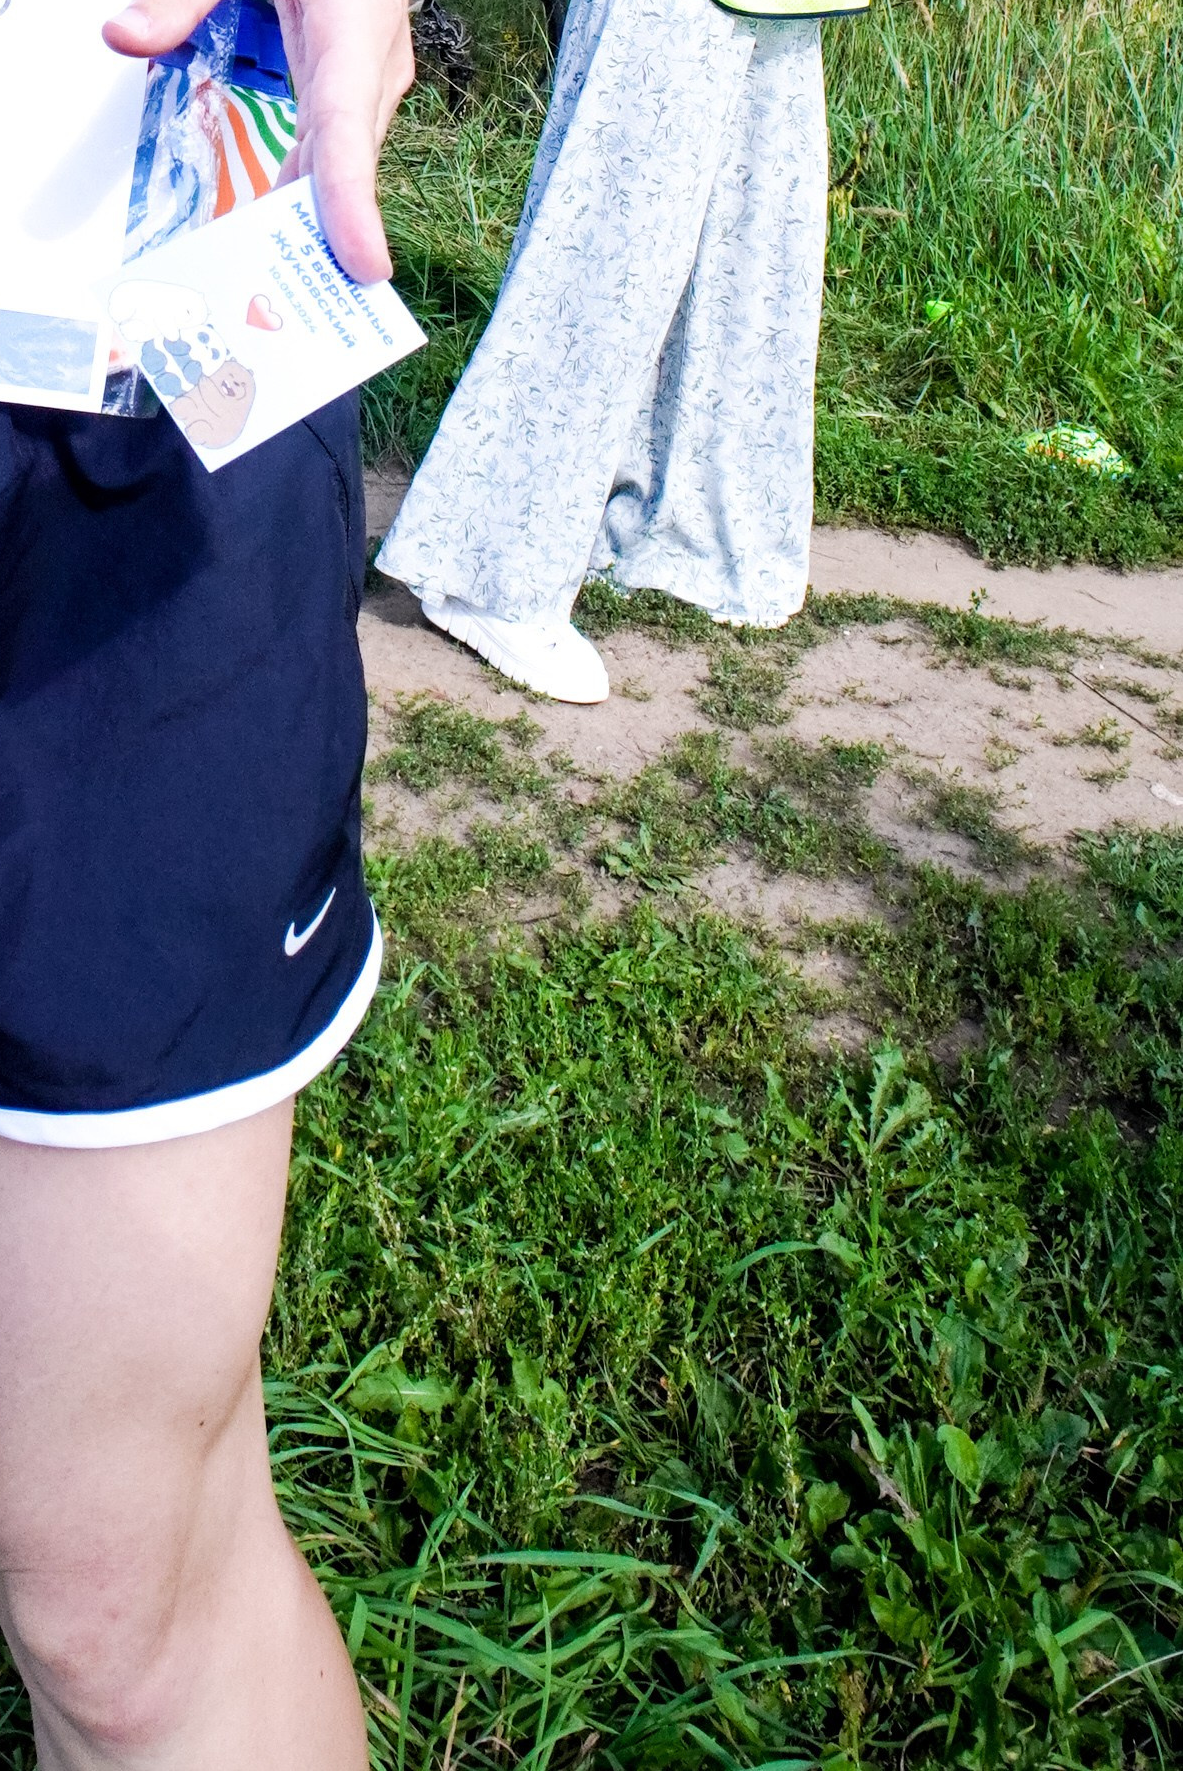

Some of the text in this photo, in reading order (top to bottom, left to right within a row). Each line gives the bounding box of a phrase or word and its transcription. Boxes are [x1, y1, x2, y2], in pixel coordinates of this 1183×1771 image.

[270, 229, 357, 348] Жуковский
[300, 243, 355, 317] 5 вёрст
